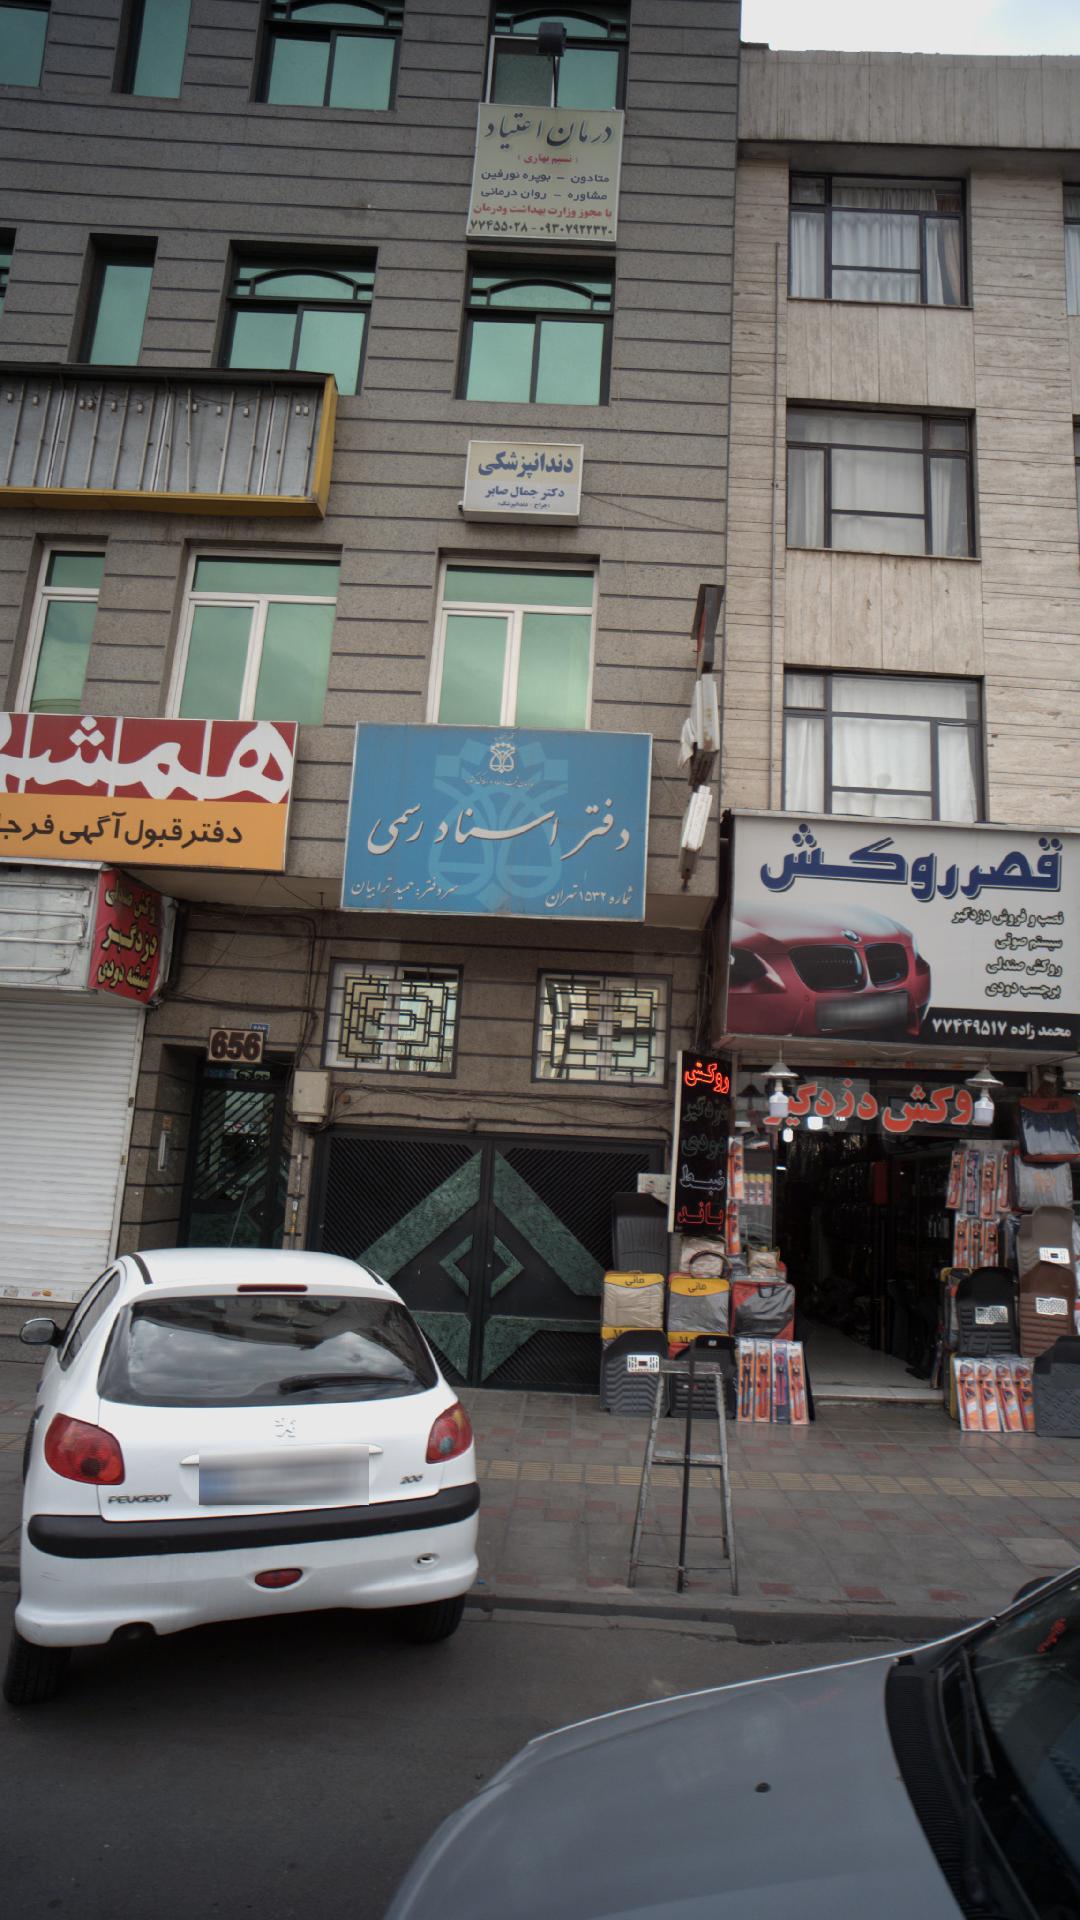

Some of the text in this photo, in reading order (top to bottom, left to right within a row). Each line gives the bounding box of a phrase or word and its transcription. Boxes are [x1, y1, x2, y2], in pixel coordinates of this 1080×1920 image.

[484, 112, 613, 149] درمان اعتیاد
[570, 173, 610, 184] متادون
[480, 187, 518, 198] درمانی
[520, 189, 547, 200] روان
[568, 191, 608, 201] مشاوره
[548, 206, 577, 218] وزارت
[478, 451, 574, 478] دندانپزشکی
[484, 485, 565, 500] دکتر جمال صابر
[59, 812, 127, 846] آگهی
[124, 818, 183, 849] قبول
[181, 819, 243, 849] دفتر
[367, 798, 630, 861] دفتر اسناد رسمی
[760, 823, 1064, 902] قصر روکش
[544, 884, 579, 908] تهران
[608, 885, 635, 905] شماره
[951, 907, 1064, 927] نصب و فروش دزدگیر
[101, 924, 158, 963] دزدگیر
[995, 932, 1063, 951] سیستم صوتی
[986, 956, 1062, 977] روکش صندلی
[985, 982, 1061, 1000] برچسب دودی
[932, 1018, 1071, 1040] محمد زاده ۷۷۴۴۹۵۱۷
[211, 1031, 261, 1061] 656
[684, 1061, 730, 1094] روکش
[680, 1164, 726, 1196] ضبط
[108, 1494, 172, 1504] PEUGEOT
